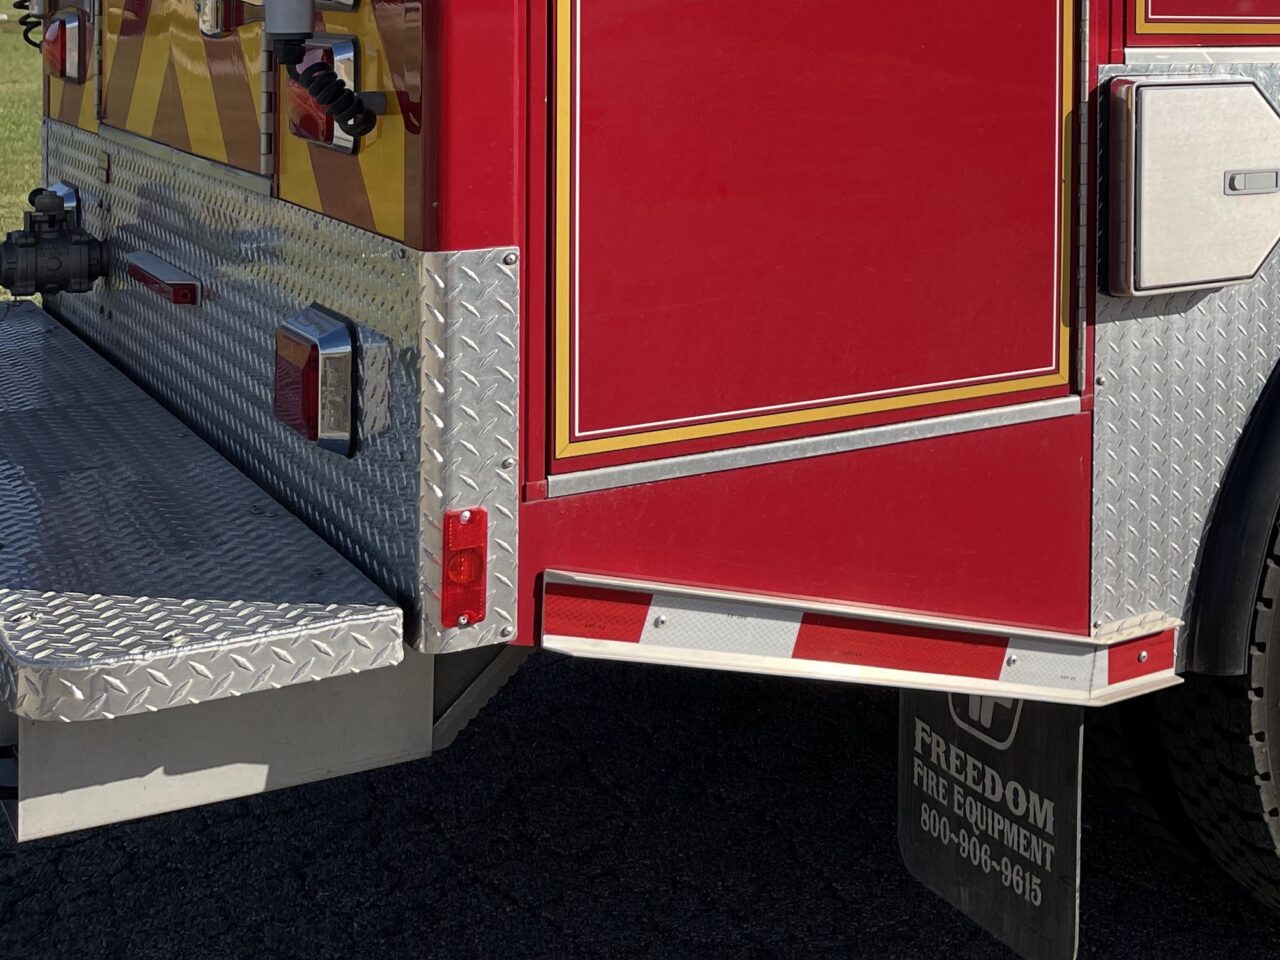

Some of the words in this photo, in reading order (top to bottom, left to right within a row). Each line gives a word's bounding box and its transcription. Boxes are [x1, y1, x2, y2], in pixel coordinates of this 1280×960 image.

[912, 756, 949, 809] FIRE
[953, 784, 1056, 873] EQUIPMENT
[913, 716, 1056, 836] FREEDOM
